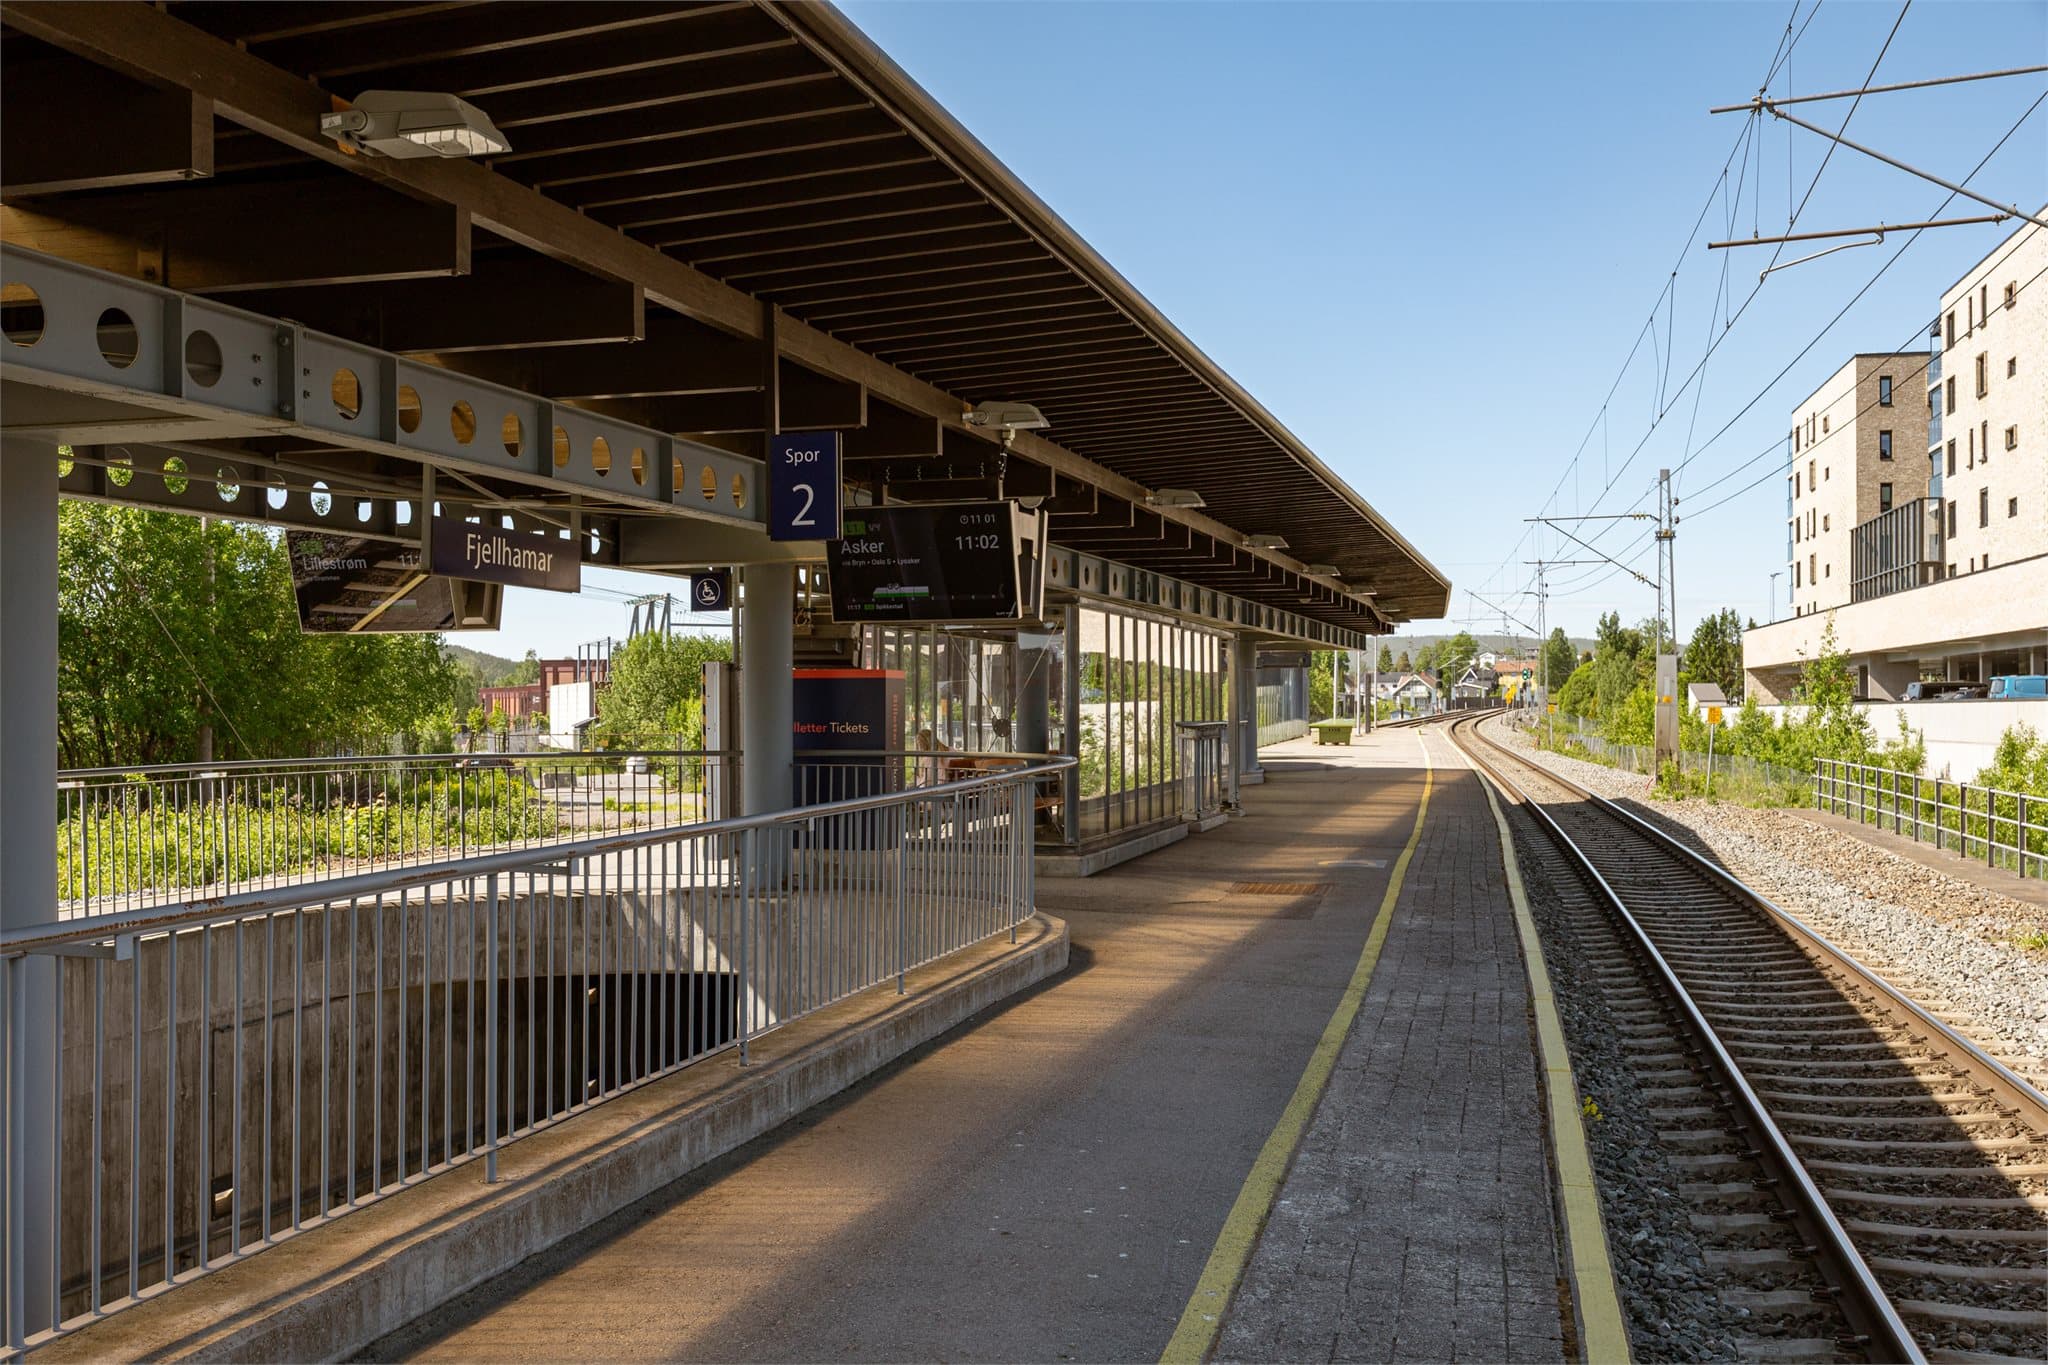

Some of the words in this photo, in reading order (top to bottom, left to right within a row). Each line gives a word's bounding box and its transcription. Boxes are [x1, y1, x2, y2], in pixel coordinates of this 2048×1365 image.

[785, 448, 820, 466] Spor
[791, 483, 816, 527] 2
[841, 538, 885, 555] Asker
[955, 534, 1000, 550] 11:02
[398, 553, 422, 568] 11:
[466, 533, 553, 573] Fjellhamar
[303, 556, 368, 571] Lillestrøm
[793, 720, 828, 733] lletter
[829, 721, 869, 733] Tickets
